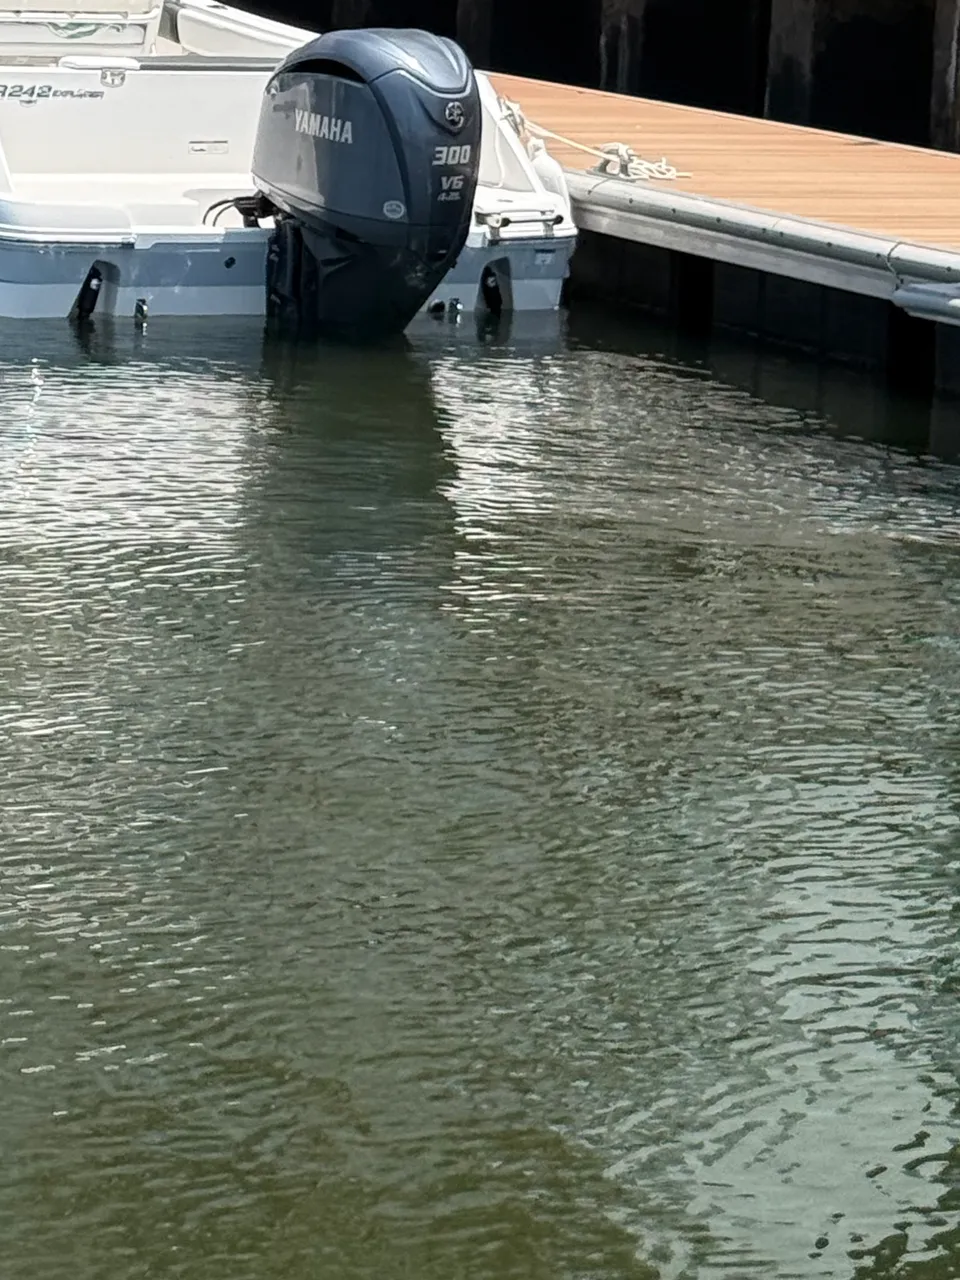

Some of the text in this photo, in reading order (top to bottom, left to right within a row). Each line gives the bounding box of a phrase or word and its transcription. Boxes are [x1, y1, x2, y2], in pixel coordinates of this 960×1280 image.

[294, 108, 353, 144] YAMAHA
[432, 145, 471, 166] 300
[441, 175, 465, 190] V6
